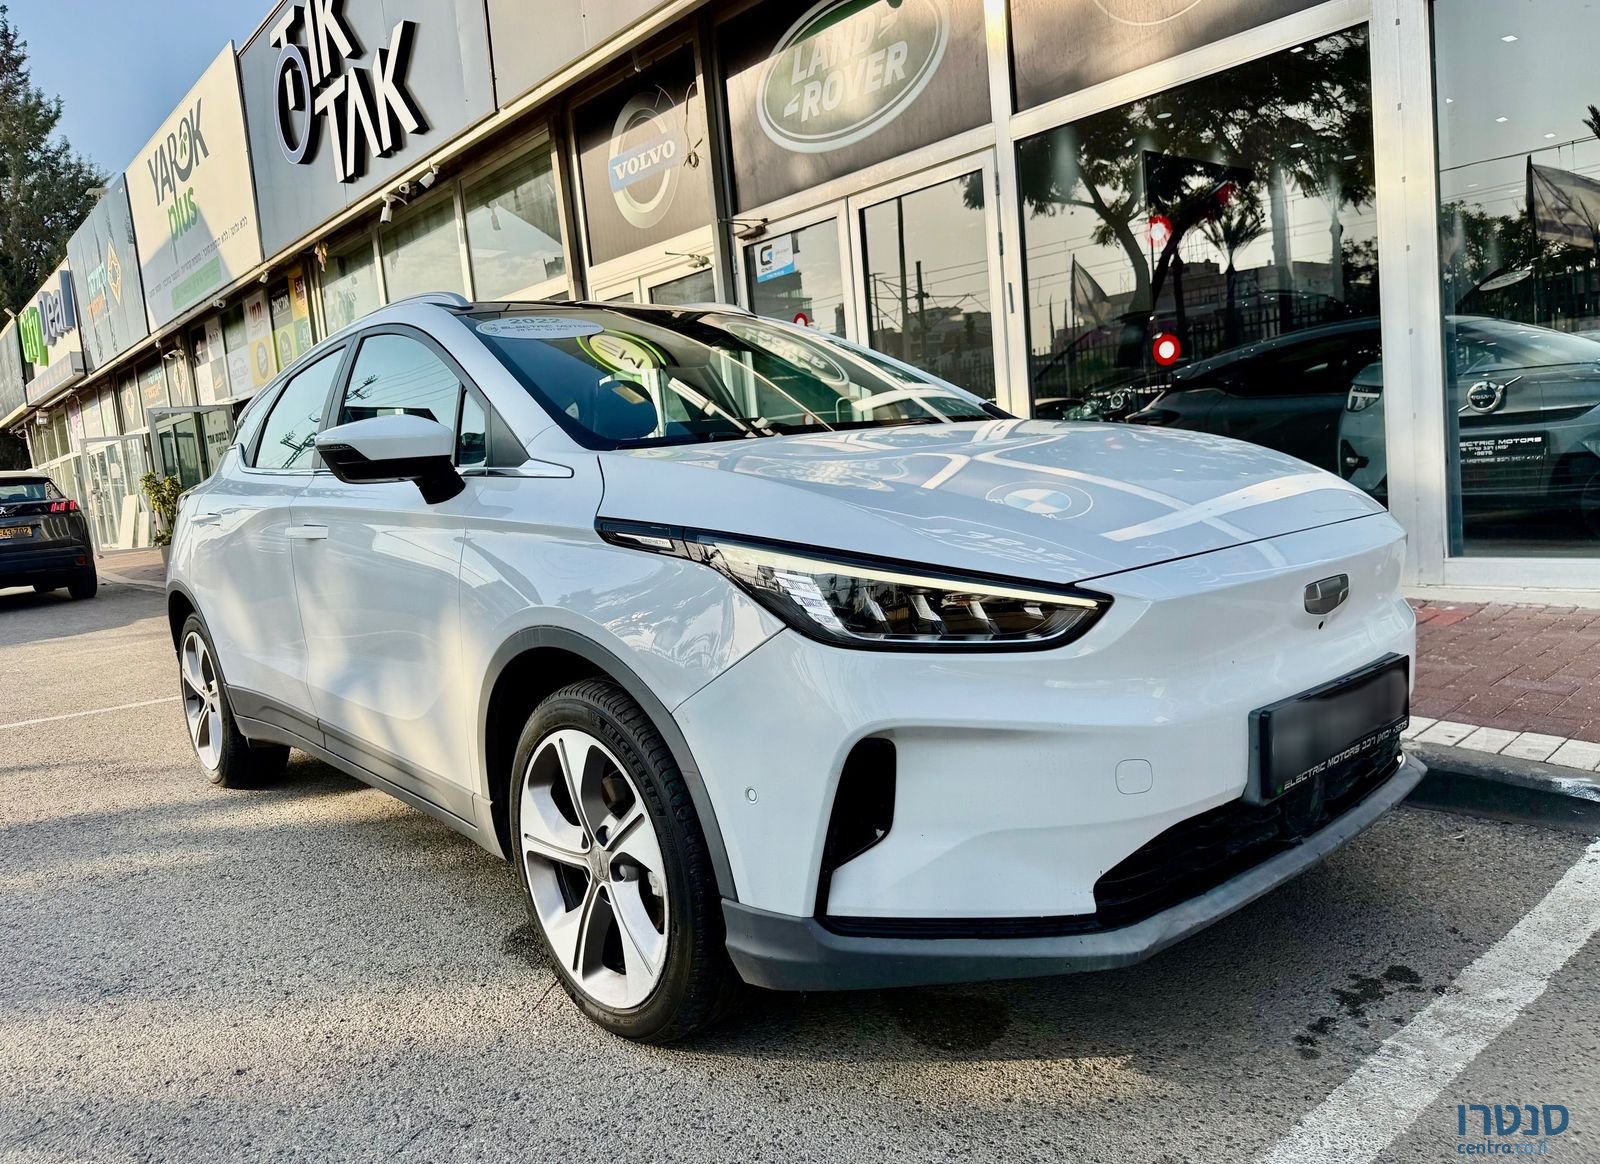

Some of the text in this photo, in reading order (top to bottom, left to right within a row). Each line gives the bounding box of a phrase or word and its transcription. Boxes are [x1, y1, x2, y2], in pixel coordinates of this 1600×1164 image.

[270, 0, 363, 88] TIK
[791, 12, 876, 86] LAND
[801, 41, 908, 122] ROVER
[315, 20, 424, 183] TAK
[147, 97, 210, 206] YAROK
[613, 140, 676, 180] VOLVO
[168, 187, 198, 264] plus
[1498, 436, 1542, 445] MOTORS
[1284, 762, 1326, 790] ELECTRIC
[1327, 744, 1360, 769] MOTORS
